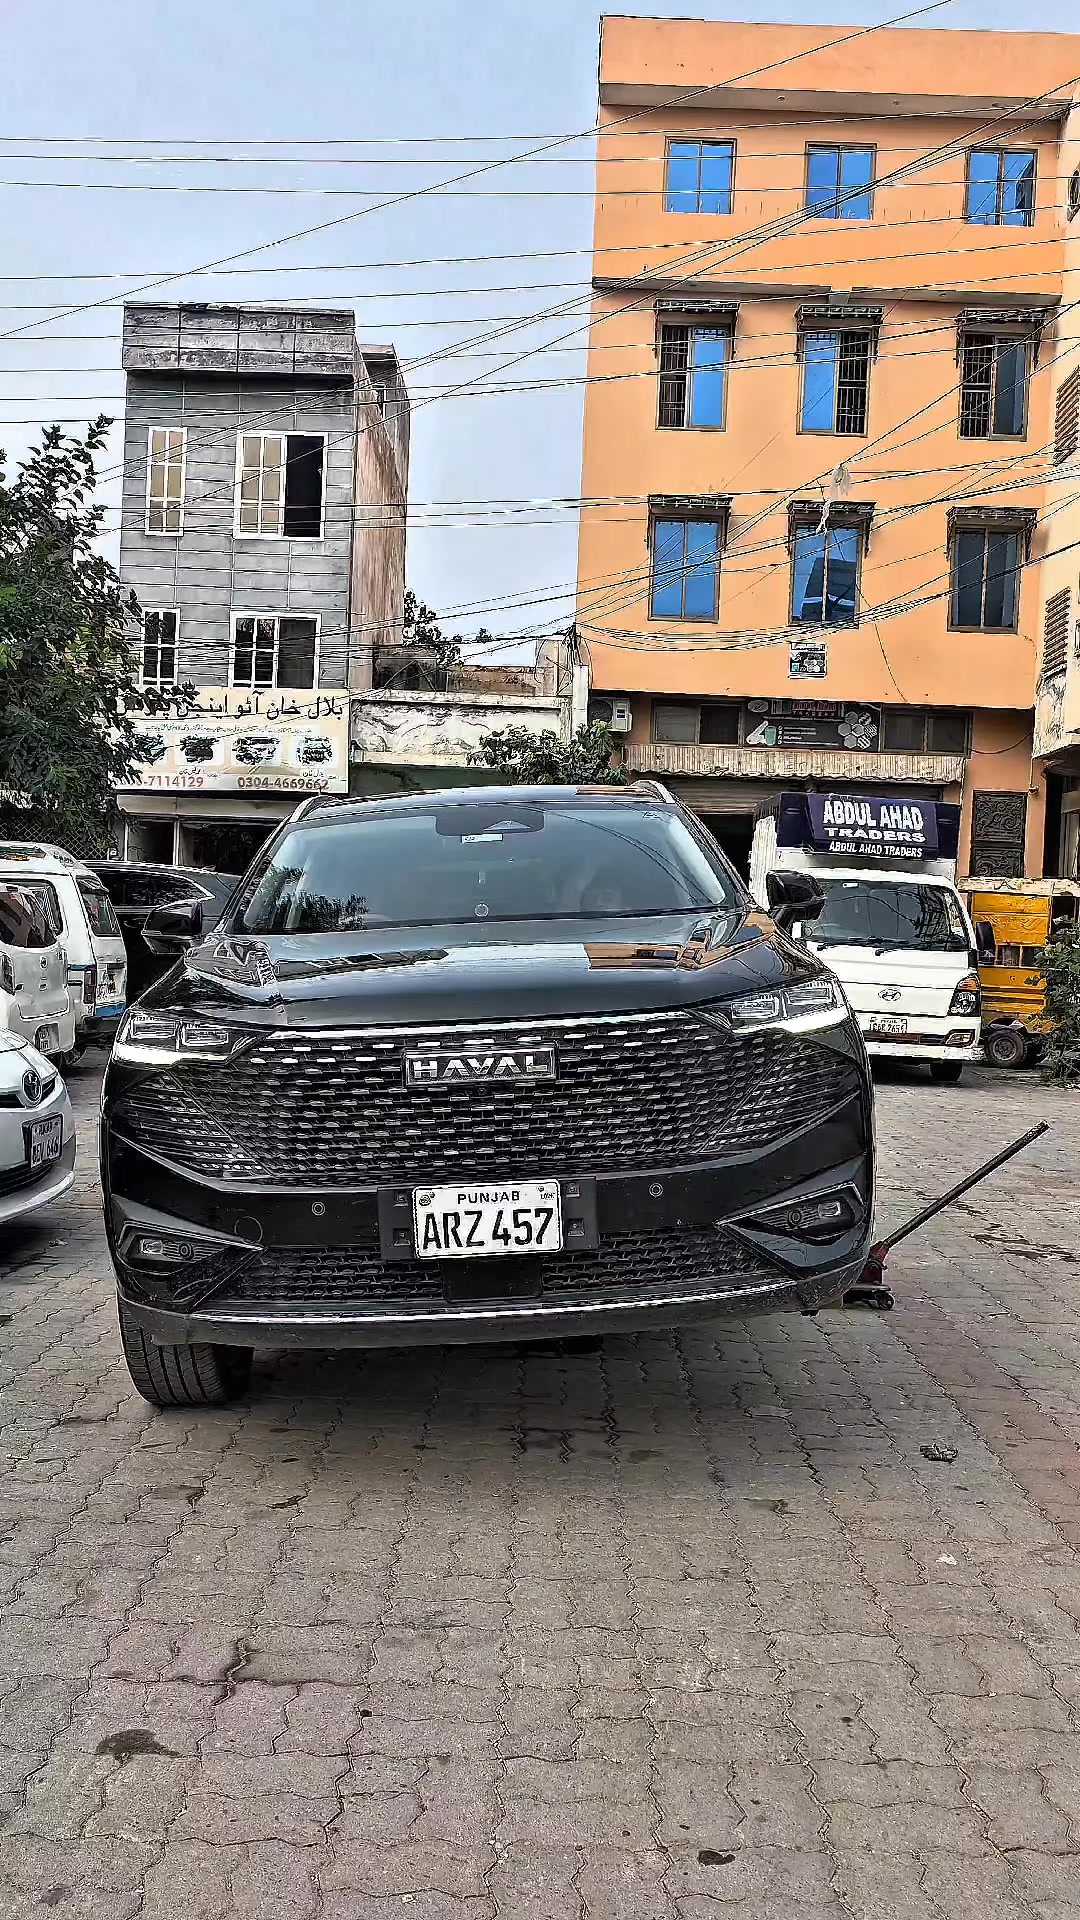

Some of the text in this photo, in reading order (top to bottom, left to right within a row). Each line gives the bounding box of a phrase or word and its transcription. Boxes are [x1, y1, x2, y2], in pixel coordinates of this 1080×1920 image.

[233, 690, 265, 719] آٹو
[266, 694, 301, 720] خان
[308, 696, 343, 720] بلال
[823, 800, 924, 831] ABDUL AHAD
[824, 827, 926, 843] TRADERS
[829, 841, 923, 858] ABDUL AHAD TRADERS
[413, 1055, 548, 1079] HAVAL
[457, 1190, 521, 1205] PUNJAB
[423, 1207, 554, 1250] ARZ 457
